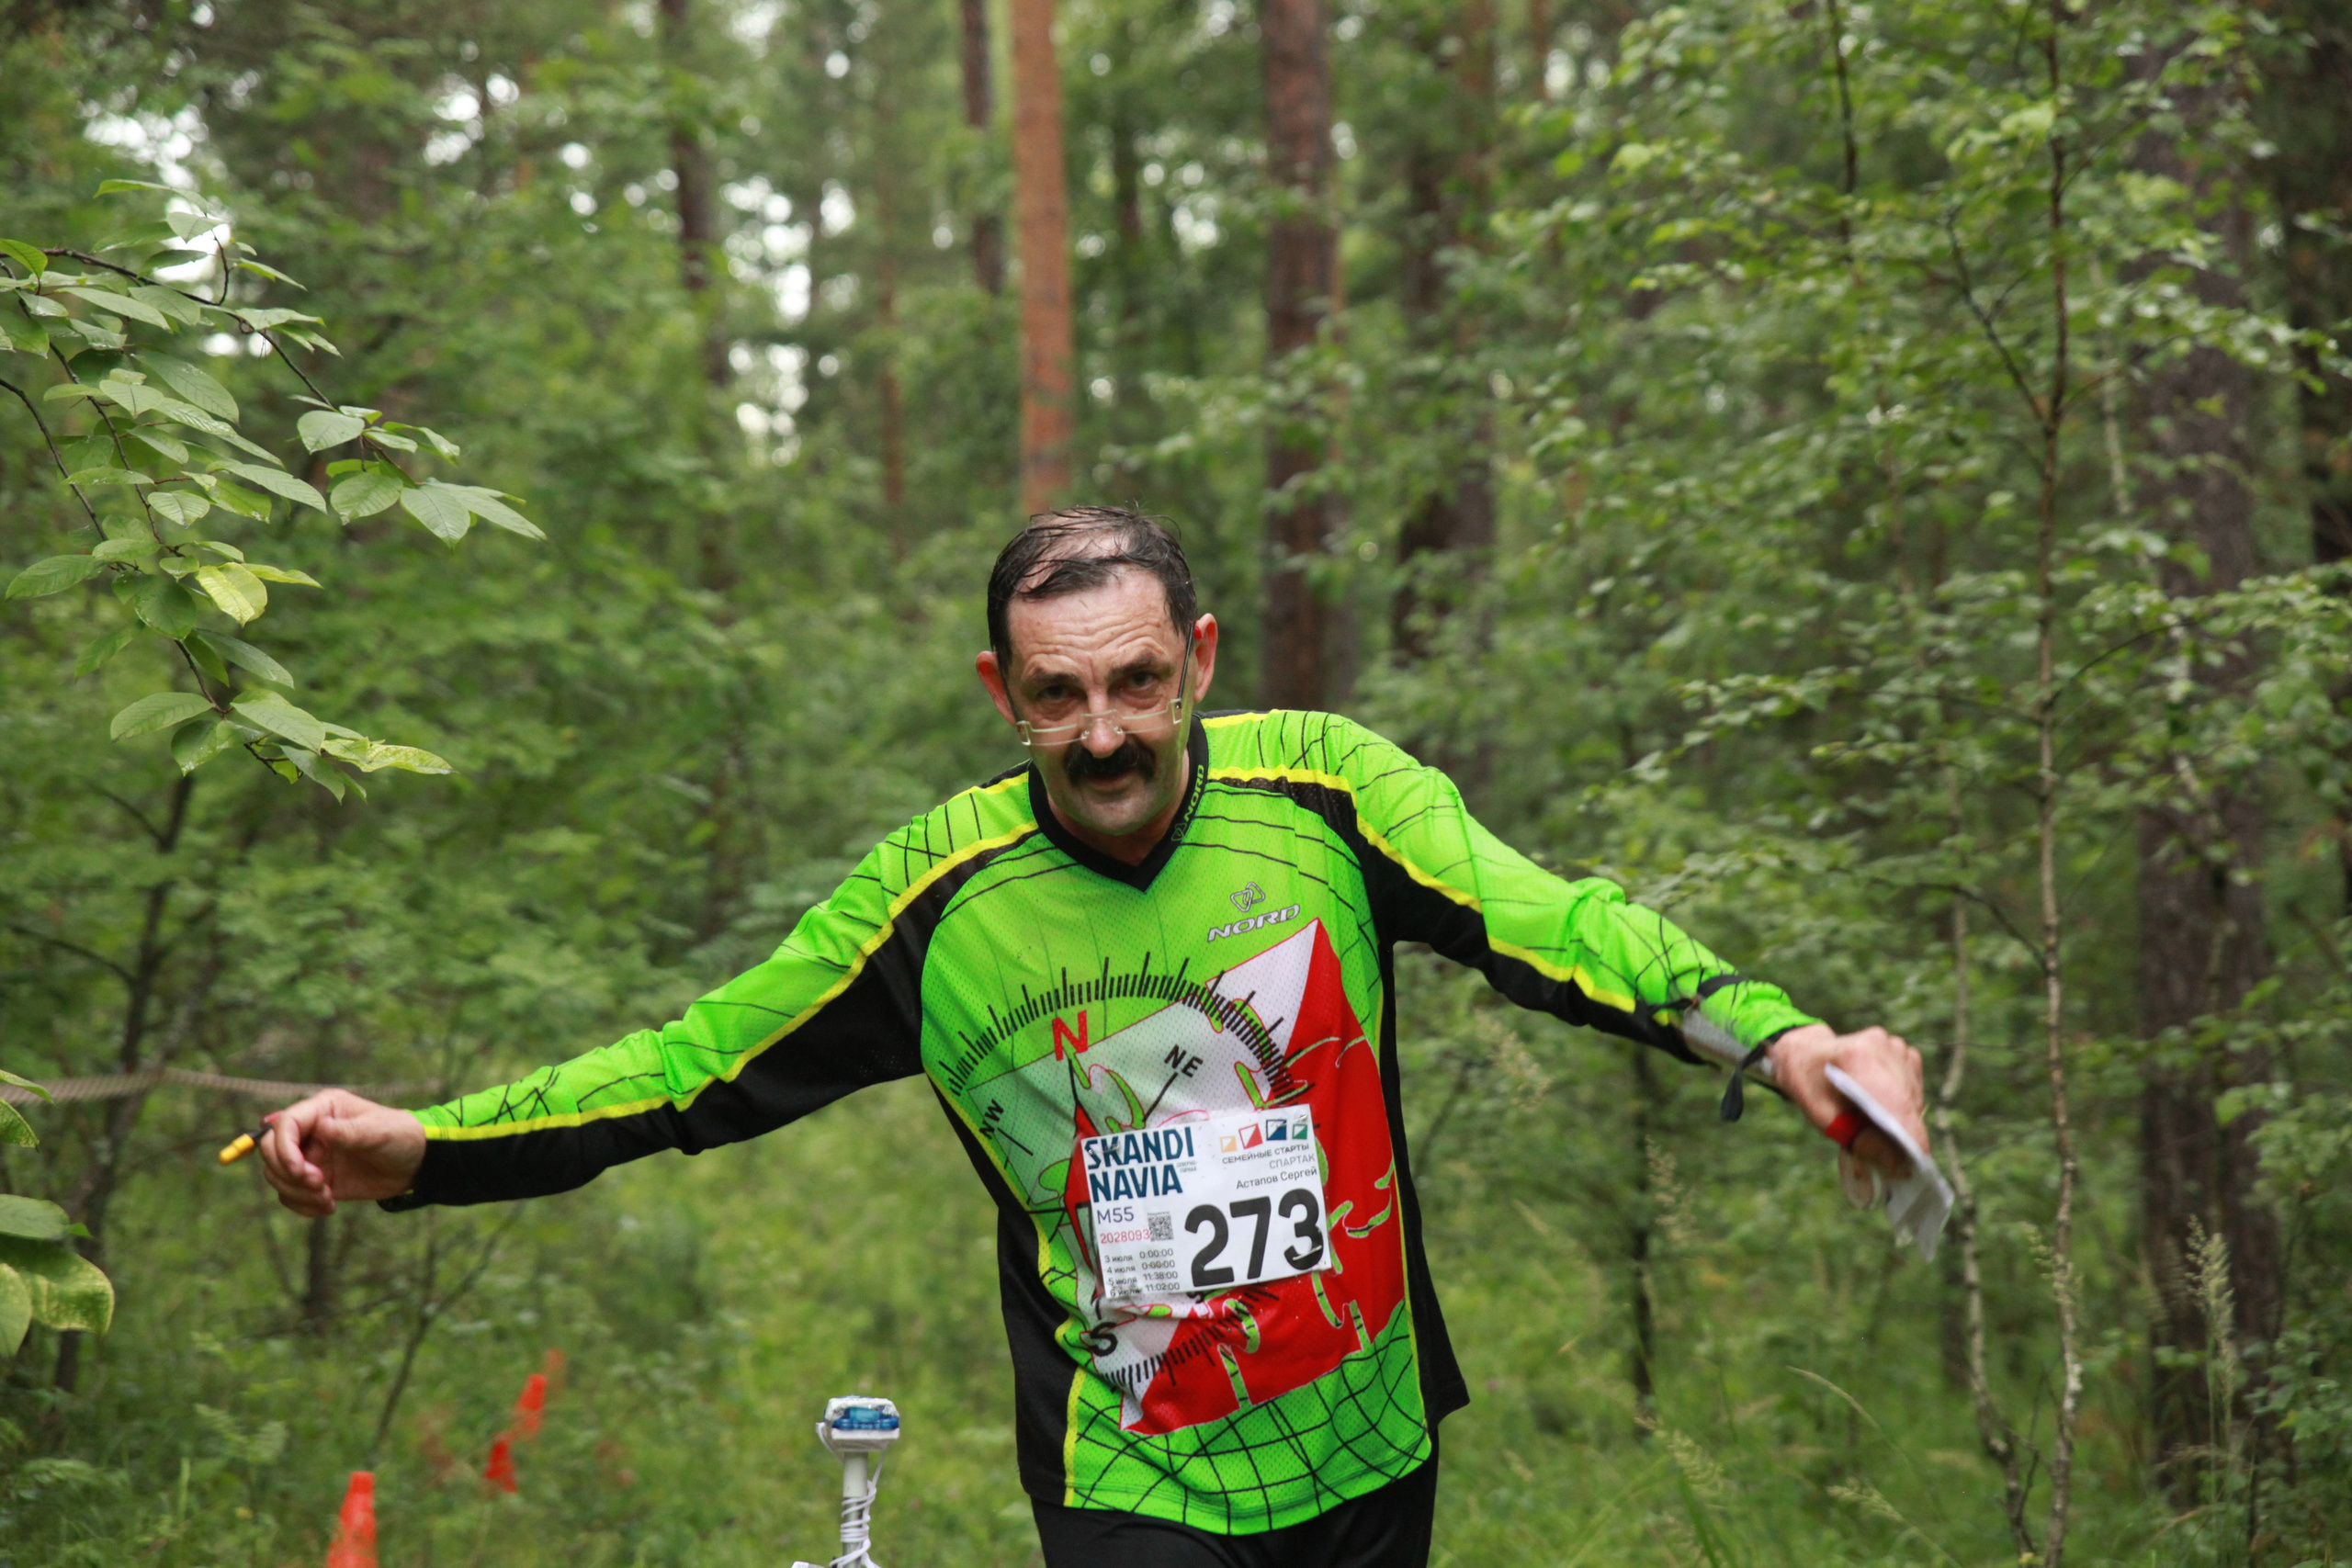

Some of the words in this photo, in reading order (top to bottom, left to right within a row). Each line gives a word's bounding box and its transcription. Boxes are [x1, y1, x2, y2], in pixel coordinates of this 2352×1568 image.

[1184, 764, 1204, 826] NORD
[1207, 903, 1300, 942] NORD
[1051, 1010, 1089, 1061] N
[1164, 1043, 1204, 1078] NE
[978, 1099, 1005, 1140] NW
[1084, 1126, 1194, 1170] SKANDI
[1222, 1149, 1272, 1165] СЕМЕЙНЫЕ
[1274, 1143, 1309, 1156] СТАРТЫ
[1269, 1154, 1317, 1169] СПАРТАК
[1090, 1163, 1183, 1202] NAVIA
[1237, 1175, 1278, 1190] Астапов
[1280, 1166, 1317, 1181] Сергей
[1100, 1228, 1151, 1245] 2028093
[1184, 1188, 1324, 1287] 273
[1104, 1255, 1111, 1263] 3
[1139, 1248, 1174, 1259] 0:00:00
[1108, 1278, 1114, 1286] 5
[1143, 1271, 1179, 1280] 11:38:00
[1146, 1282, 1181, 1292] 11:02:00
[1090, 1322, 1118, 1357] S
